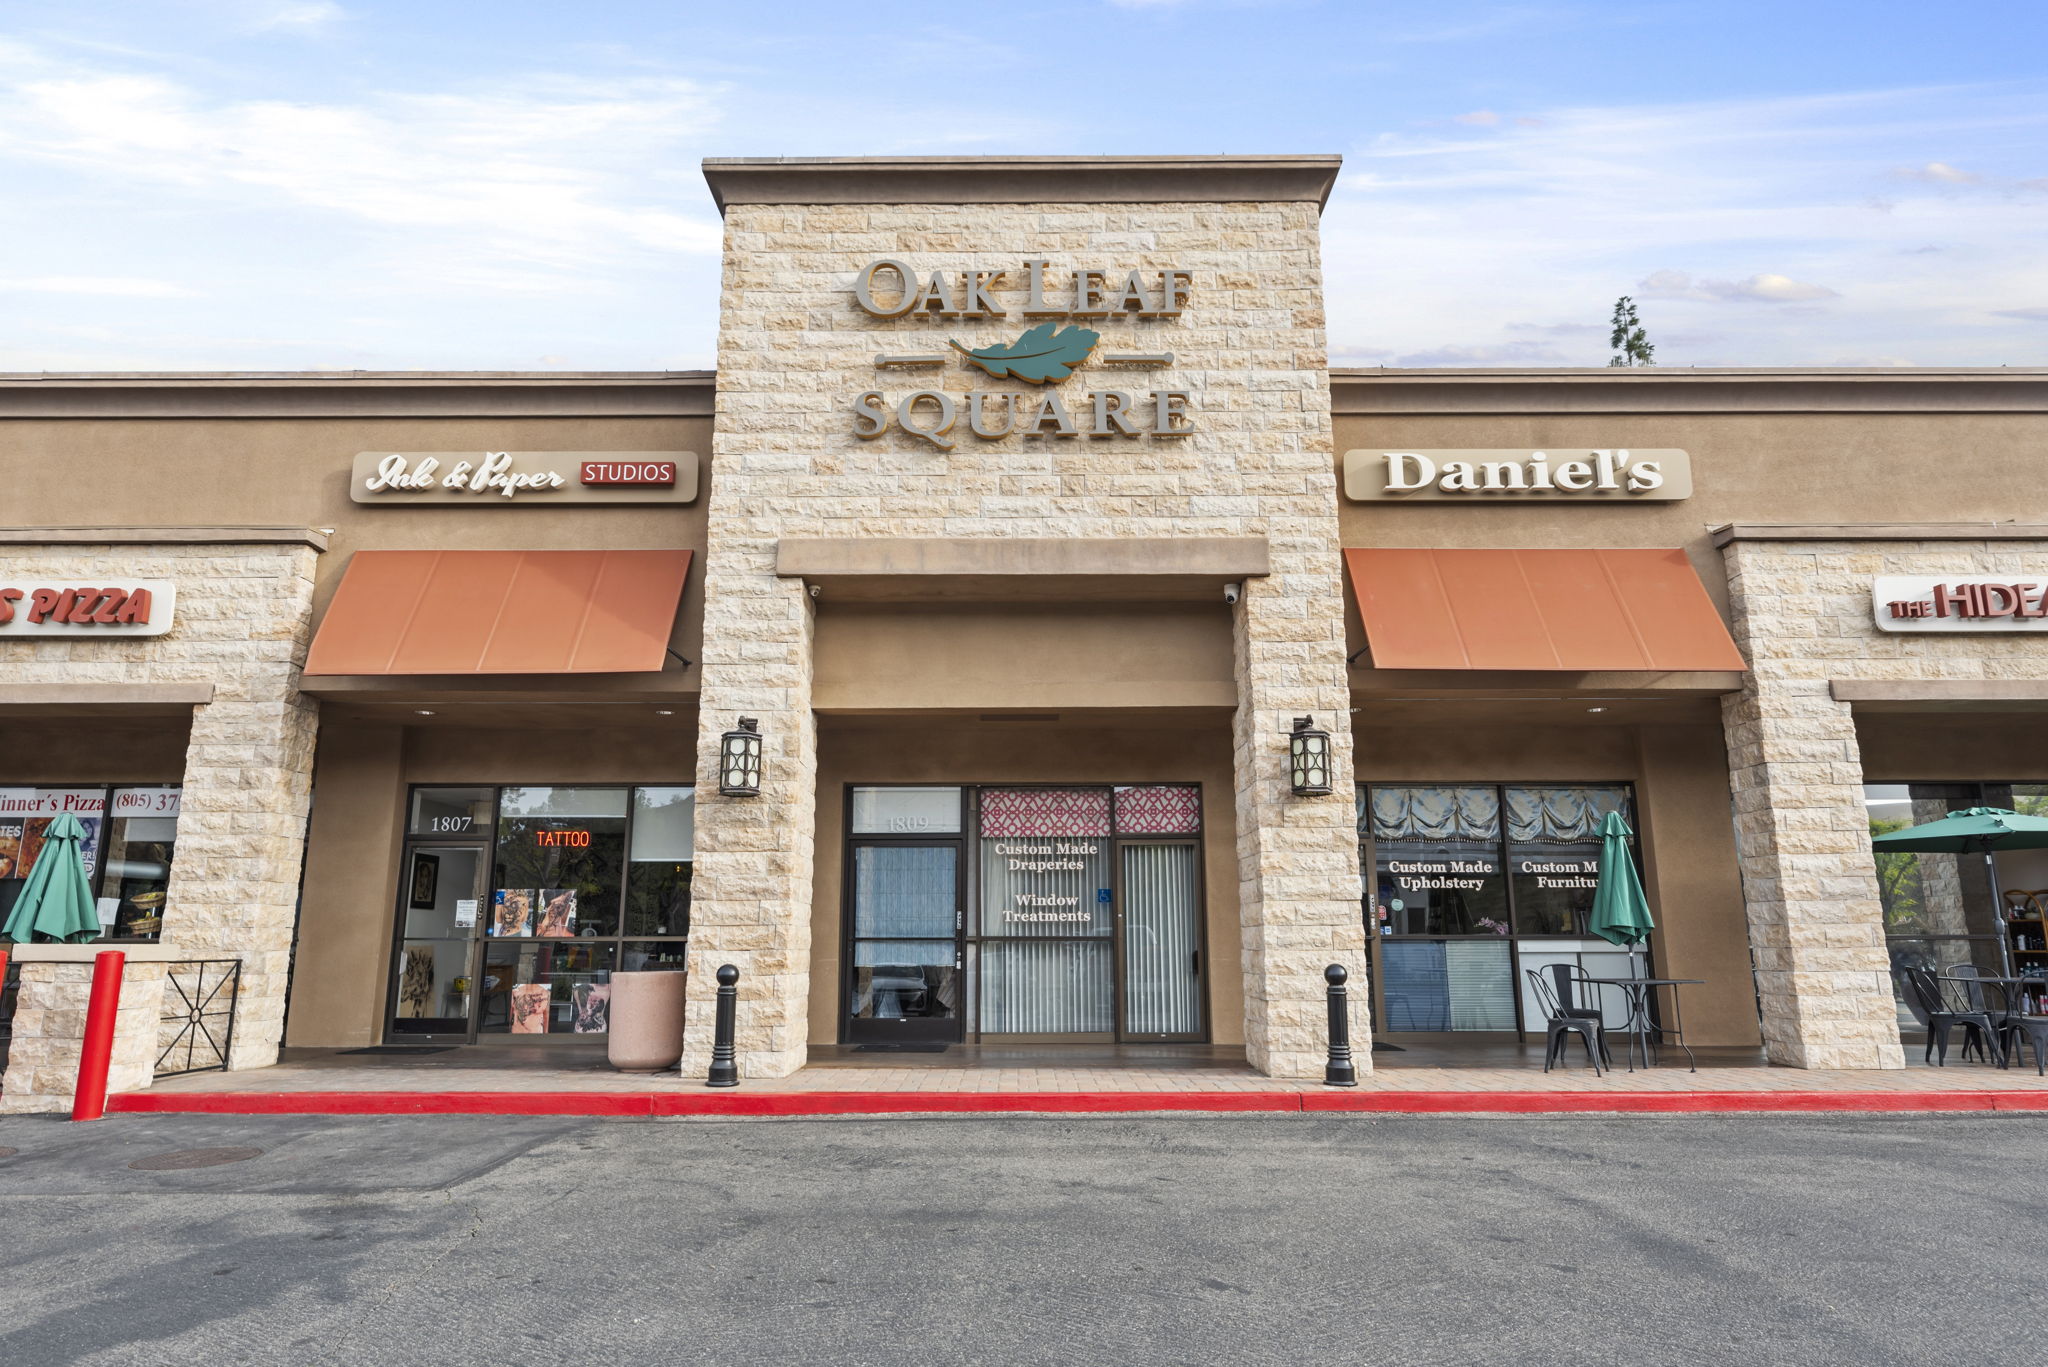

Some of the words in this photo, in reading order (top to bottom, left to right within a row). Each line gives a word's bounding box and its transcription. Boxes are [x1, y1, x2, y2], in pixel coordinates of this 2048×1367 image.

[855, 259, 1007, 319] OAK
[1022, 260, 1193, 318] LEAF
[854, 389, 1195, 450] SQUARE
[366, 454, 438, 491] Ink
[442, 461, 472, 490] &
[470, 451, 566, 498] Paper
[584, 464, 670, 482] STUDIOS
[1382, 449, 1663, 491] Daniel's
[27, 588, 152, 624] PIZZA
[1887, 600, 1933, 618] THE
[1933, 583, 2048, 618] HIDE
[0, 794, 57, 811] inner's
[63, 794, 105, 811] Pizza
[116, 794, 151, 809] (805)
[155, 794, 181, 811] 37
[431, 816, 471, 832] 1807
[889, 816, 929, 832] 1809
[537, 831, 590, 847] TATTOO
[995, 843, 1051, 855] Custom
[1056, 843, 1097, 855] Made
[1009, 858, 1084, 873] Draperies
[1388, 861, 1447, 873] Custom
[1450, 861, 1492, 873] Made
[1521, 861, 1580, 873] Custom
[1400, 876, 1484, 891] Upholstery
[1015, 894, 1079, 906] Window
[1003, 910, 1091, 922] Treatments
